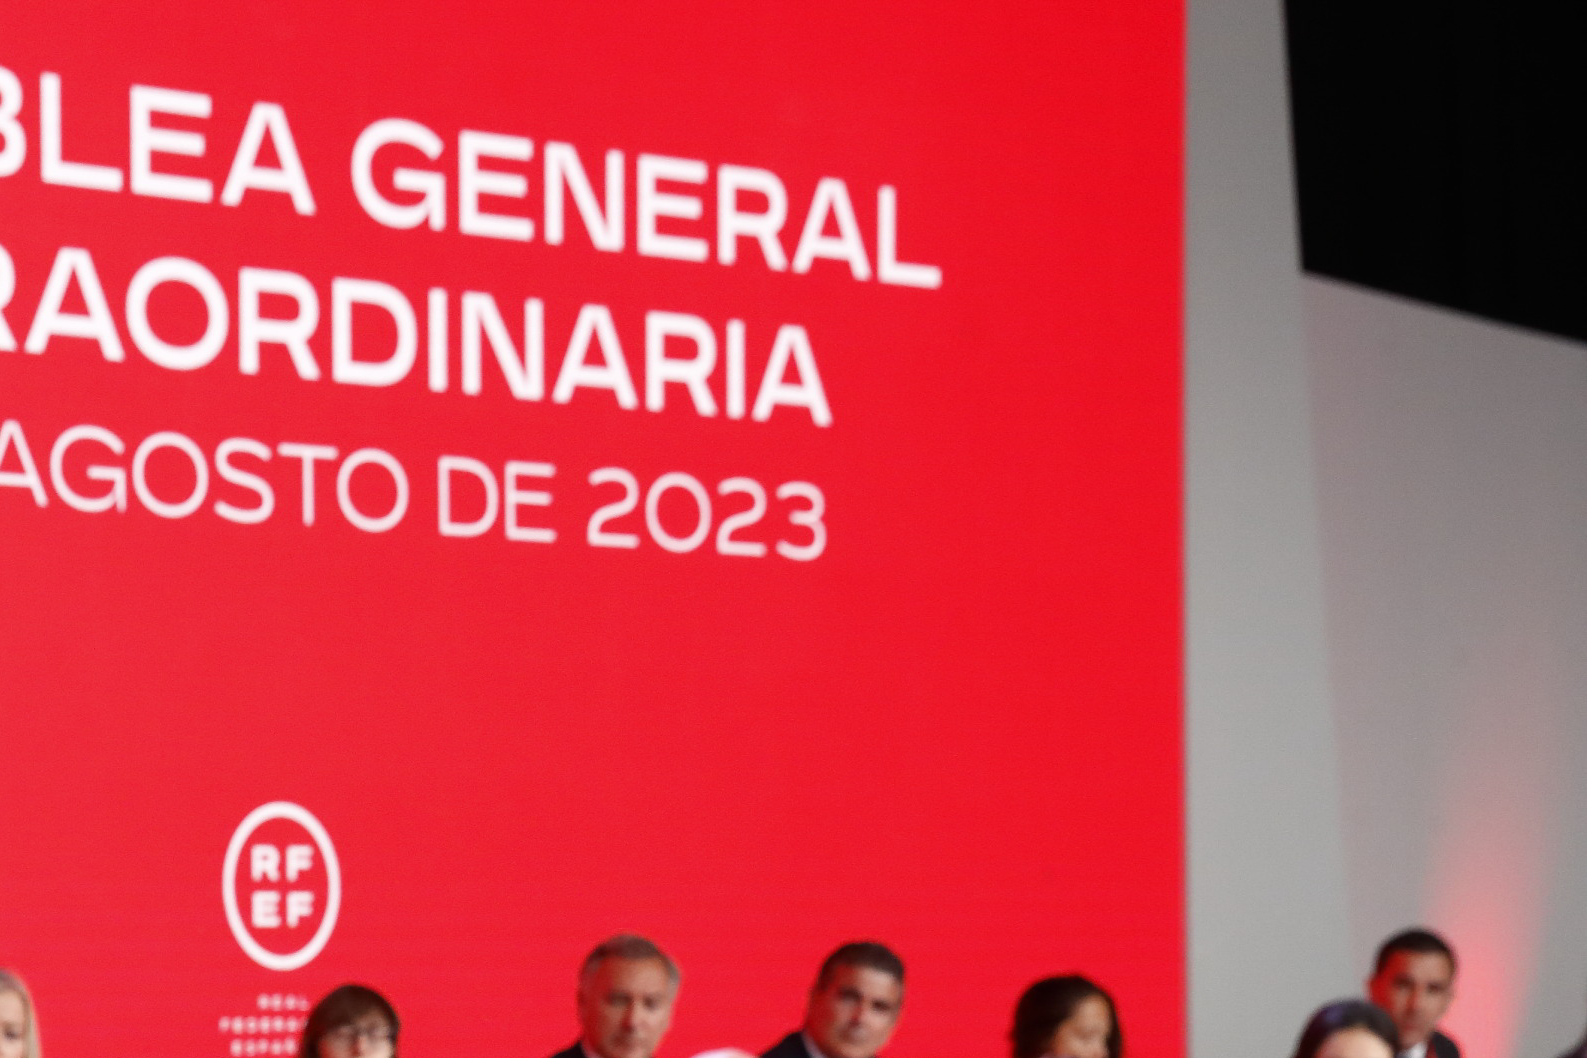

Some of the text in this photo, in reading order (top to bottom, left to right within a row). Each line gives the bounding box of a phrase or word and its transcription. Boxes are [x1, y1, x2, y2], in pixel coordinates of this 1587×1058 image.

[351, 118, 942, 289] GENERAL
[437, 455, 556, 543] DE
[587, 467, 826, 561] 2023
